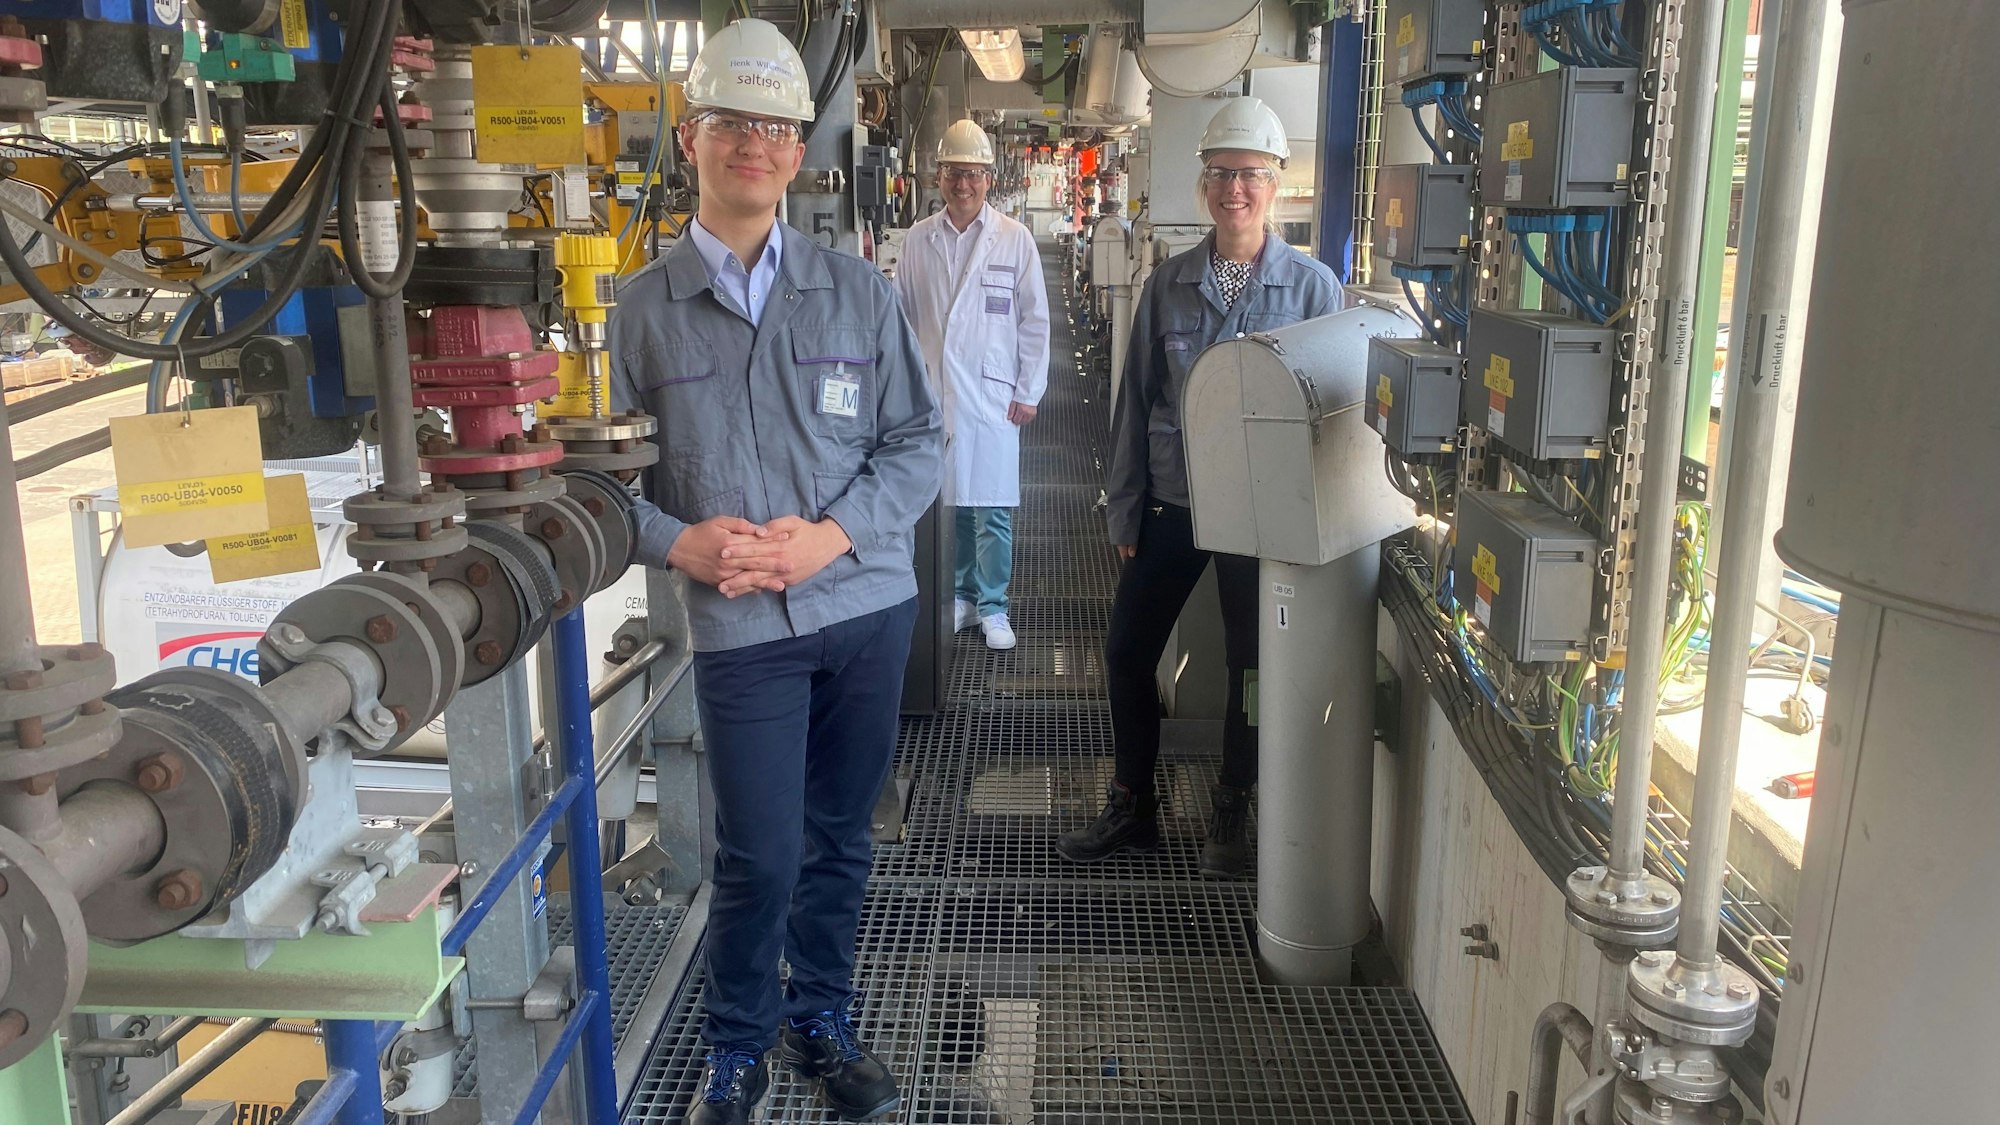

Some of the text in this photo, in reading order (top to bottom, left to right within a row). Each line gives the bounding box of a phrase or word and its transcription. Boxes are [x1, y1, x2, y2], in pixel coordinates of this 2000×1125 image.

[736, 74, 781, 90] saltigo
[490, 116, 566, 125] R500-UB04-V0051
[813, 212, 838, 249] 5
[1679, 299, 1690, 314] bar
[1776, 314, 1787, 331] bar
[1673, 323, 1688, 365] Druckluft
[1769, 341, 1784, 388] Druckluft
[842, 387, 858, 410] M
[141, 484, 243, 504] R500-UB04-V0050
[222, 533, 298, 550] R500-UB04-V0081
[1274, 585, 1293, 595] UB 05
[229, 612, 268, 624] TOLUENE)
